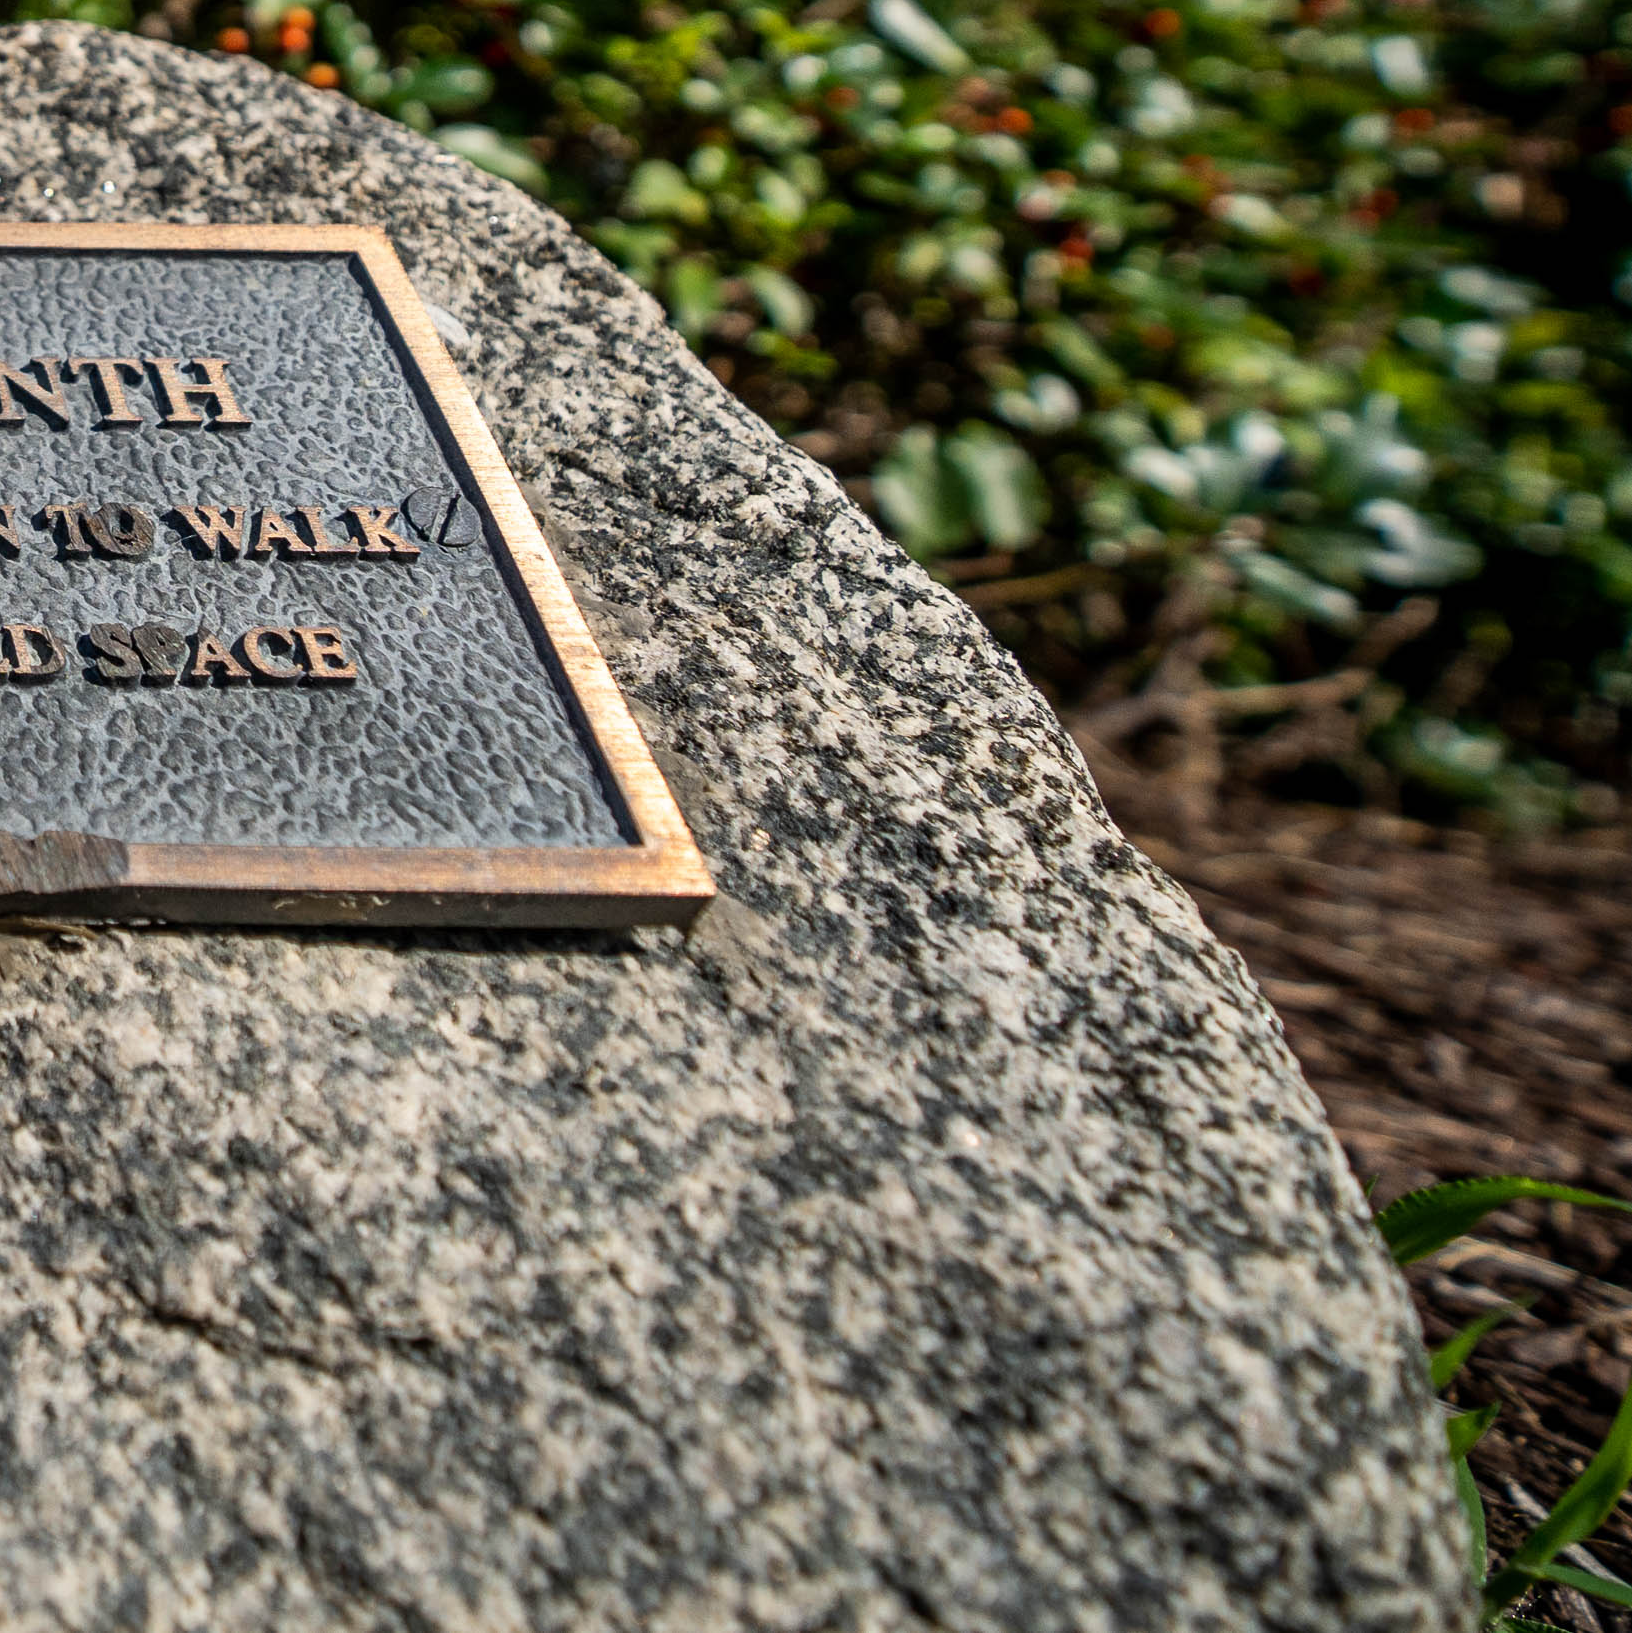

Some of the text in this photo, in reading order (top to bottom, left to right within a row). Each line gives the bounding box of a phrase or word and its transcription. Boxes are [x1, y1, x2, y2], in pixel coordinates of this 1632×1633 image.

[41, 501, 155, 556] TO
[171, 504, 422, 556] WALK
[89, 621, 359, 681] SPACE
